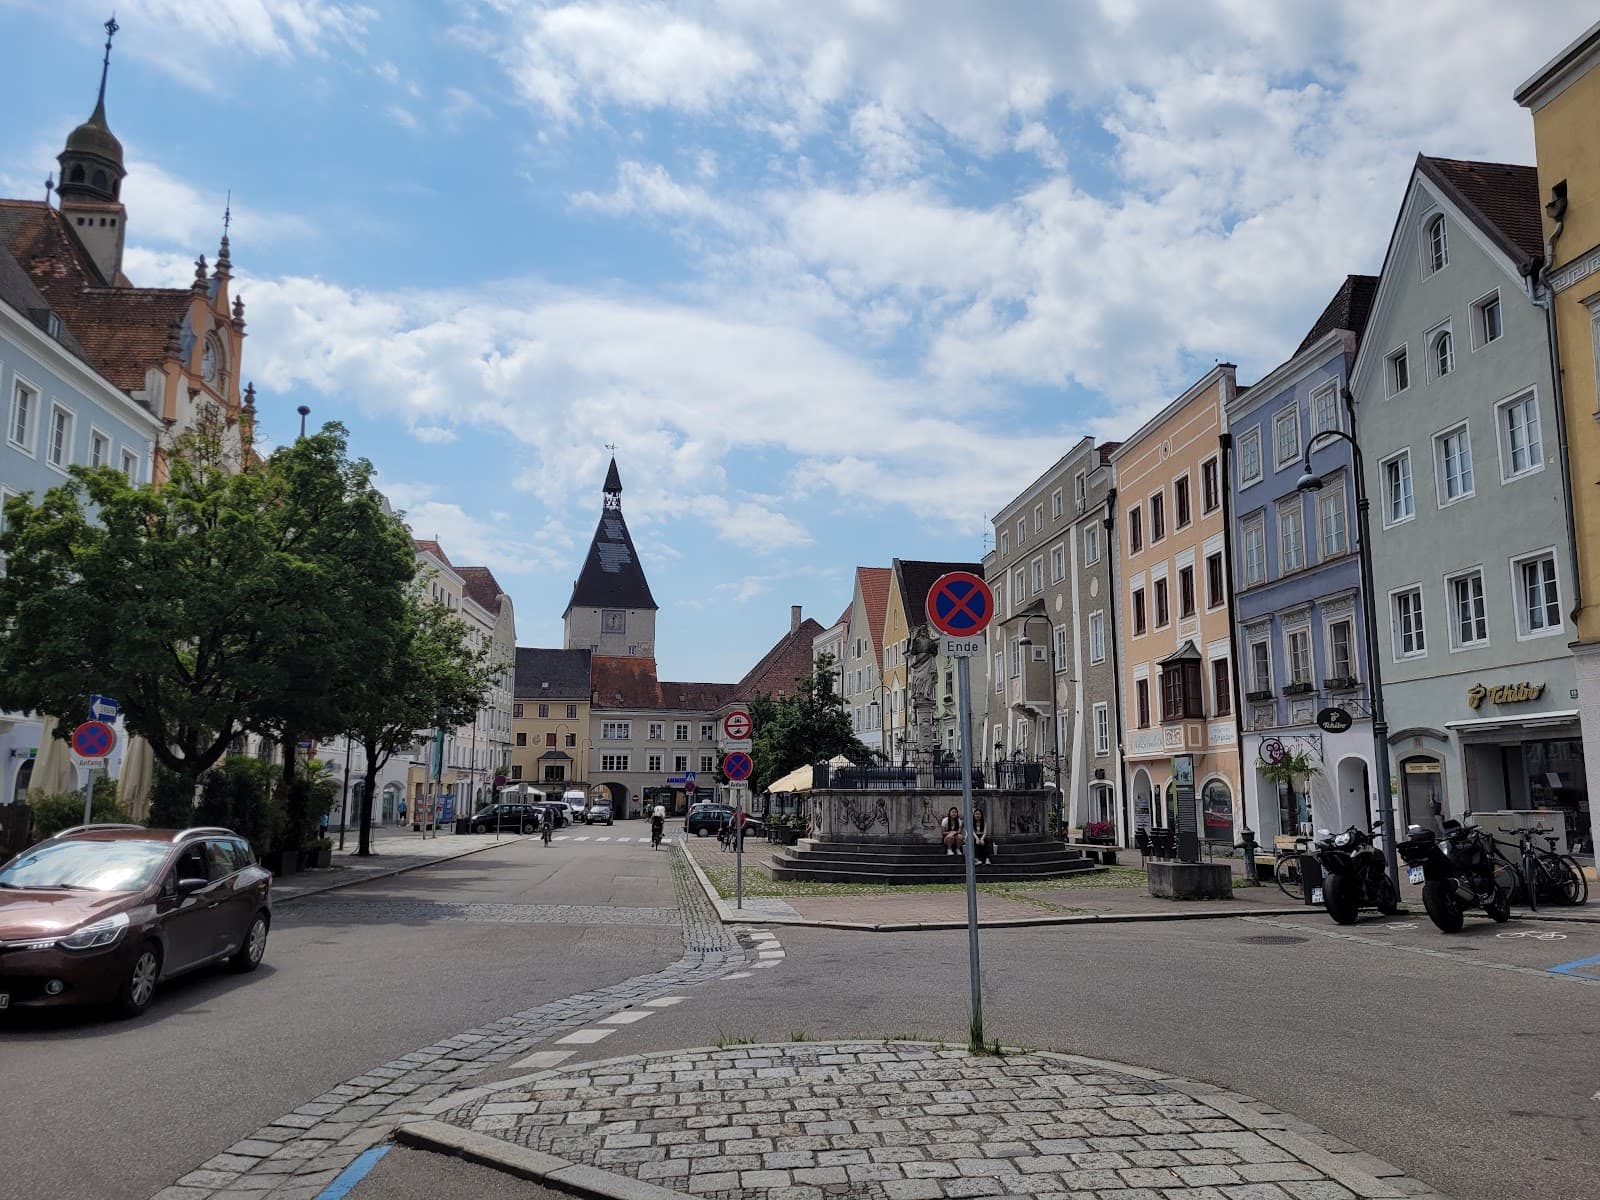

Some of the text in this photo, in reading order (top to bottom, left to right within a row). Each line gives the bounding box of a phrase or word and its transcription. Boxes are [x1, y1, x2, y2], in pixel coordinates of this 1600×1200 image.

[947, 640, 978, 652] Ende
[1488, 681, 1545, 704] Tchibo
[1322, 721, 1347, 729] Tchibo
